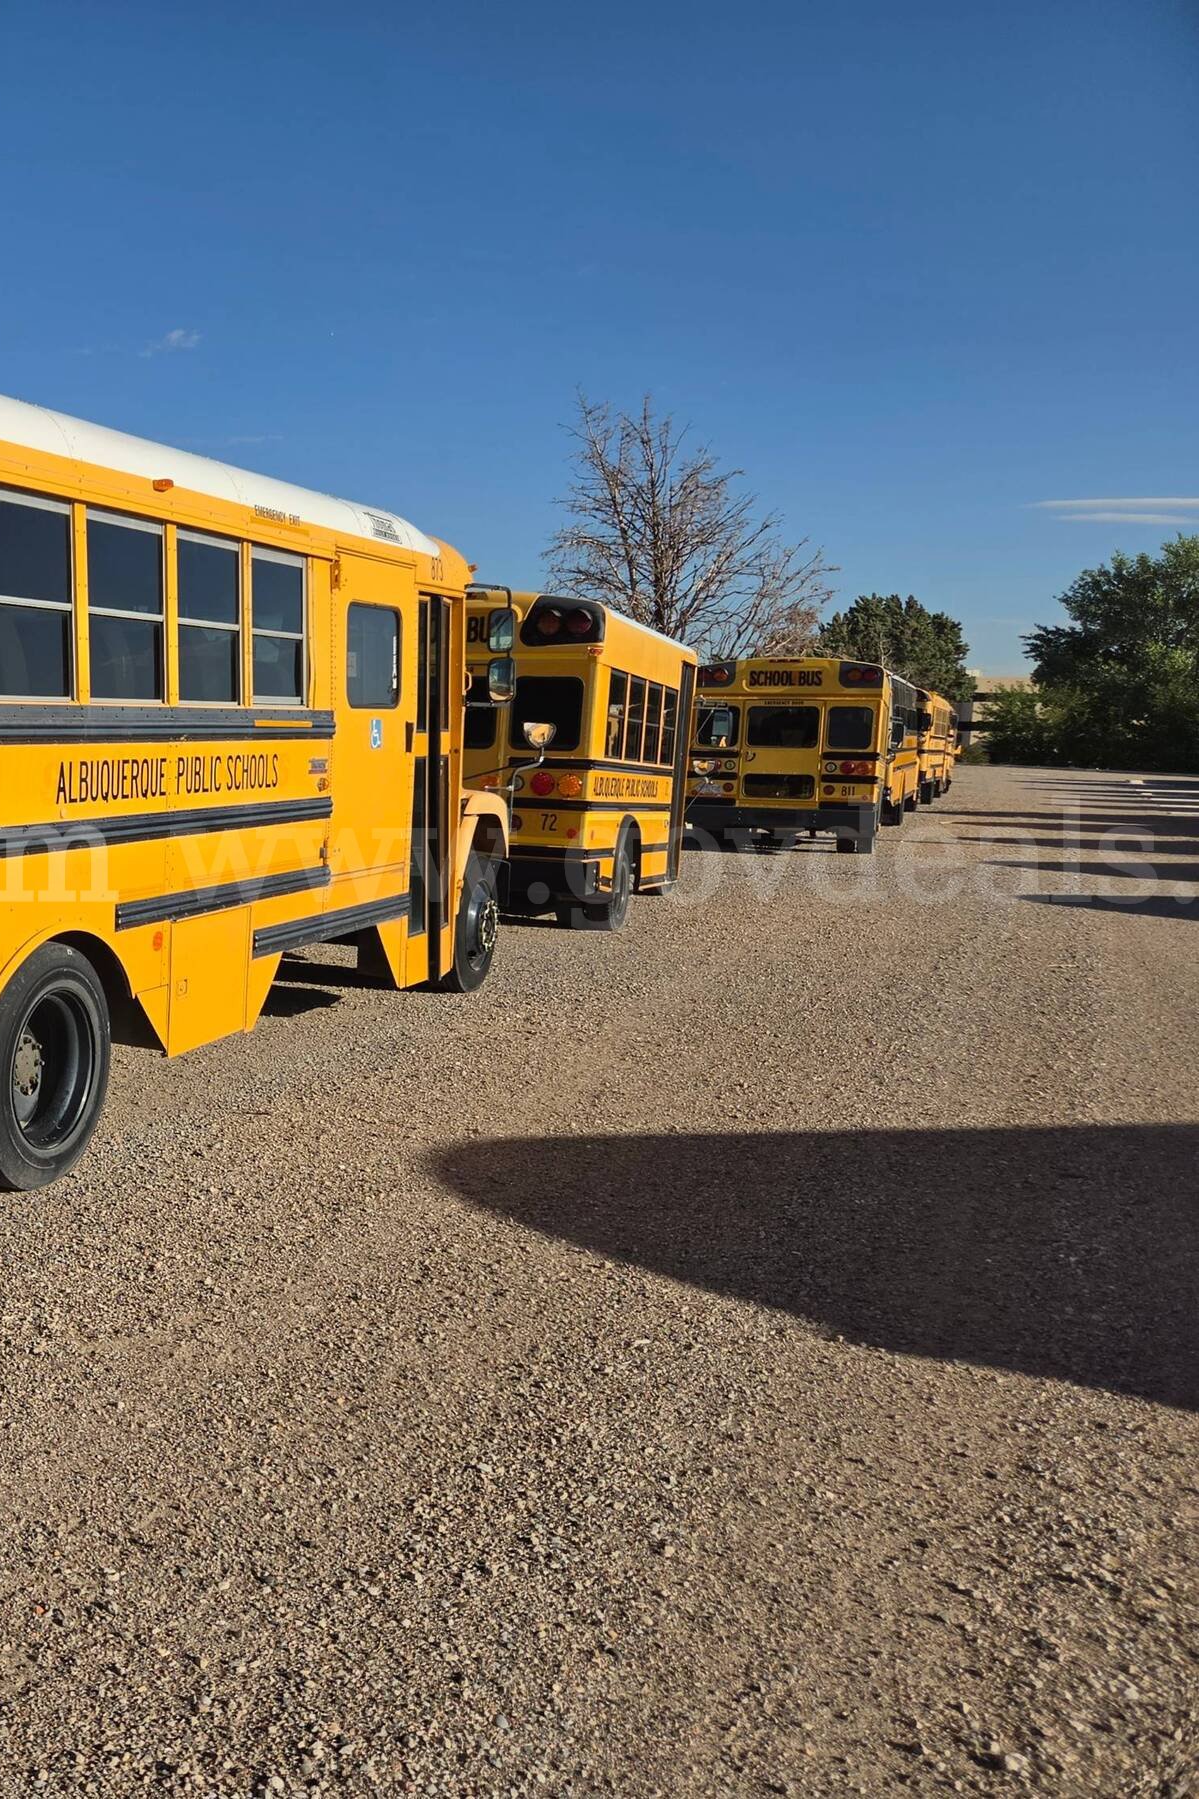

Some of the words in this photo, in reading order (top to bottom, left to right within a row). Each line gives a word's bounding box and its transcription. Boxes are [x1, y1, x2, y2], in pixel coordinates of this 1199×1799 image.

[430, 556, 444, 582] 873
[467, 616, 489, 642] BU
[749, 670, 796, 687] SCHOOL
[798, 670, 823, 687] BUS
[56, 757, 168, 804] ALBUQUERQUE
[176, 755, 222, 795] PUBLIC
[227, 753, 279, 791] SCHOOLS
[841, 785, 855, 797] 811
[541, 813, 558, 832] 72
